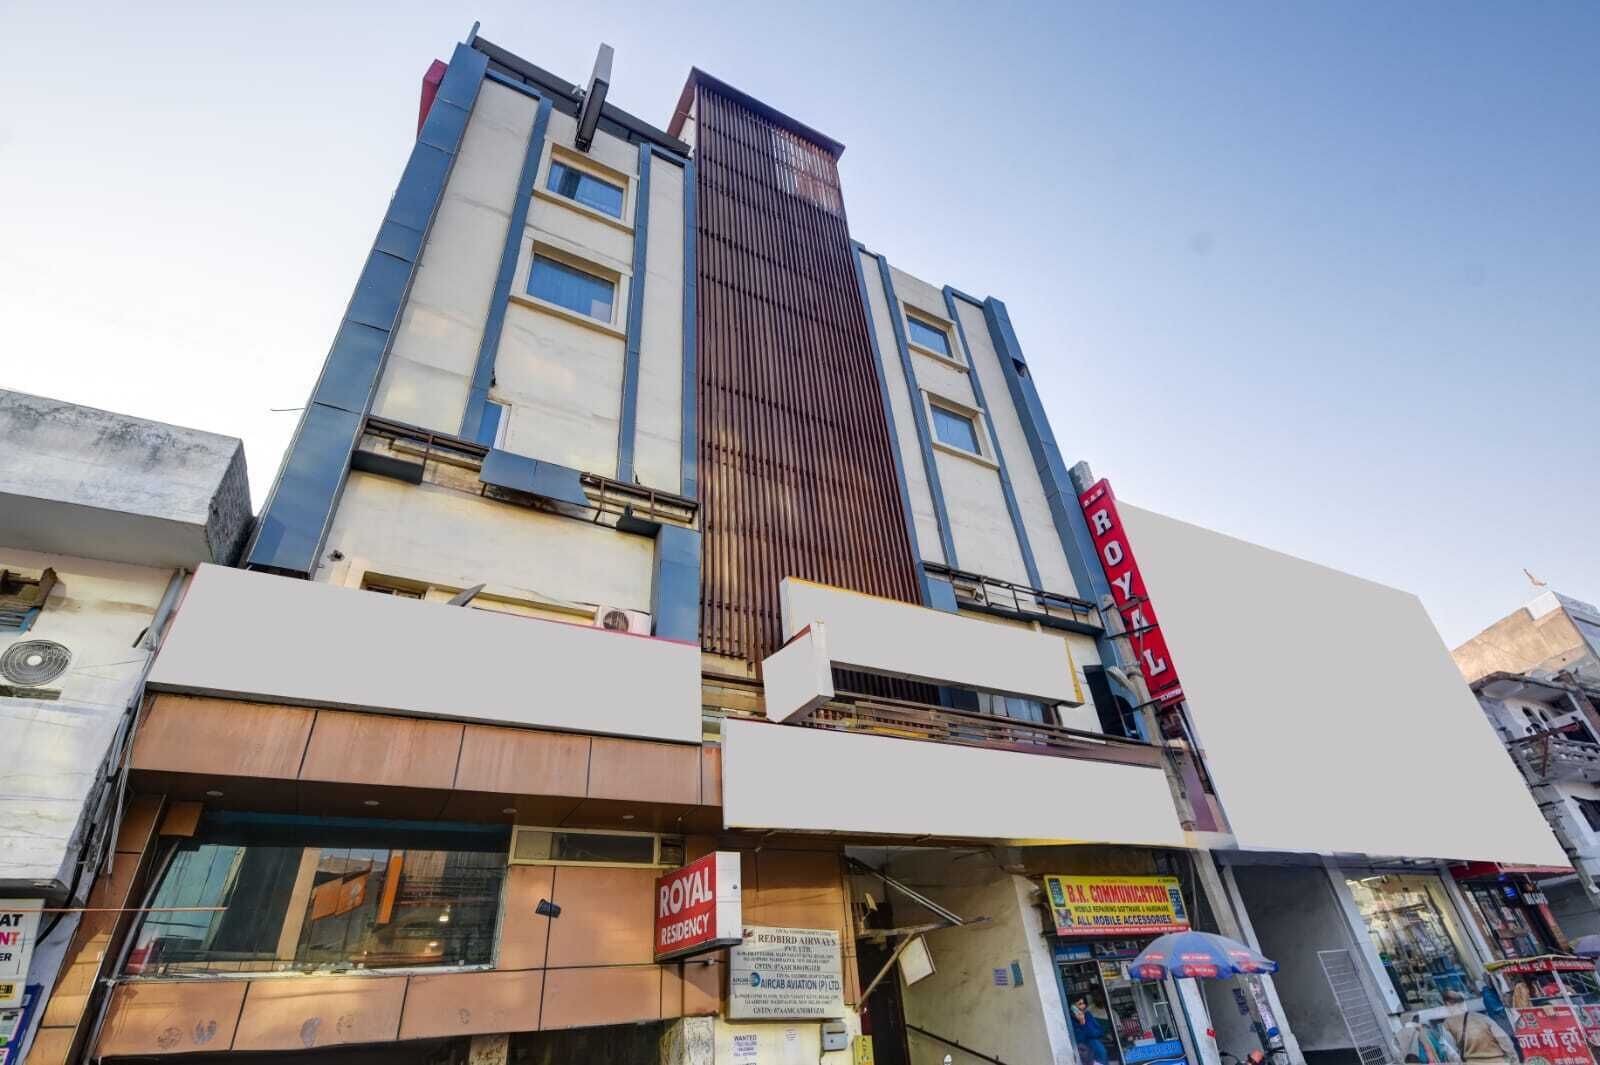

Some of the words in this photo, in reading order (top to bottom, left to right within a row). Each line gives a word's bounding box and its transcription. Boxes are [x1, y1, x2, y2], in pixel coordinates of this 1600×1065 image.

[1091, 508, 1167, 677] ROYAL
[660, 866, 713, 918] ROYAL
[1089, 884, 1169, 903] COMMUNICATION
[1077, 915, 1091, 925] ALL
[1094, 915, 1121, 925] MOBILE
[1123, 914, 1172, 925] ACCESSORIES
[661, 912, 709, 945] RESIDENCY
[758, 934, 797, 944] REDBIRD
[799, 936, 837, 946] AIRWAYS
[761, 978, 785, 989] AIRCAB
[786, 979, 817, 989] AVIATION
[819, 980, 828, 991] (P)
[1515, 1034, 1540, 1048] जय
